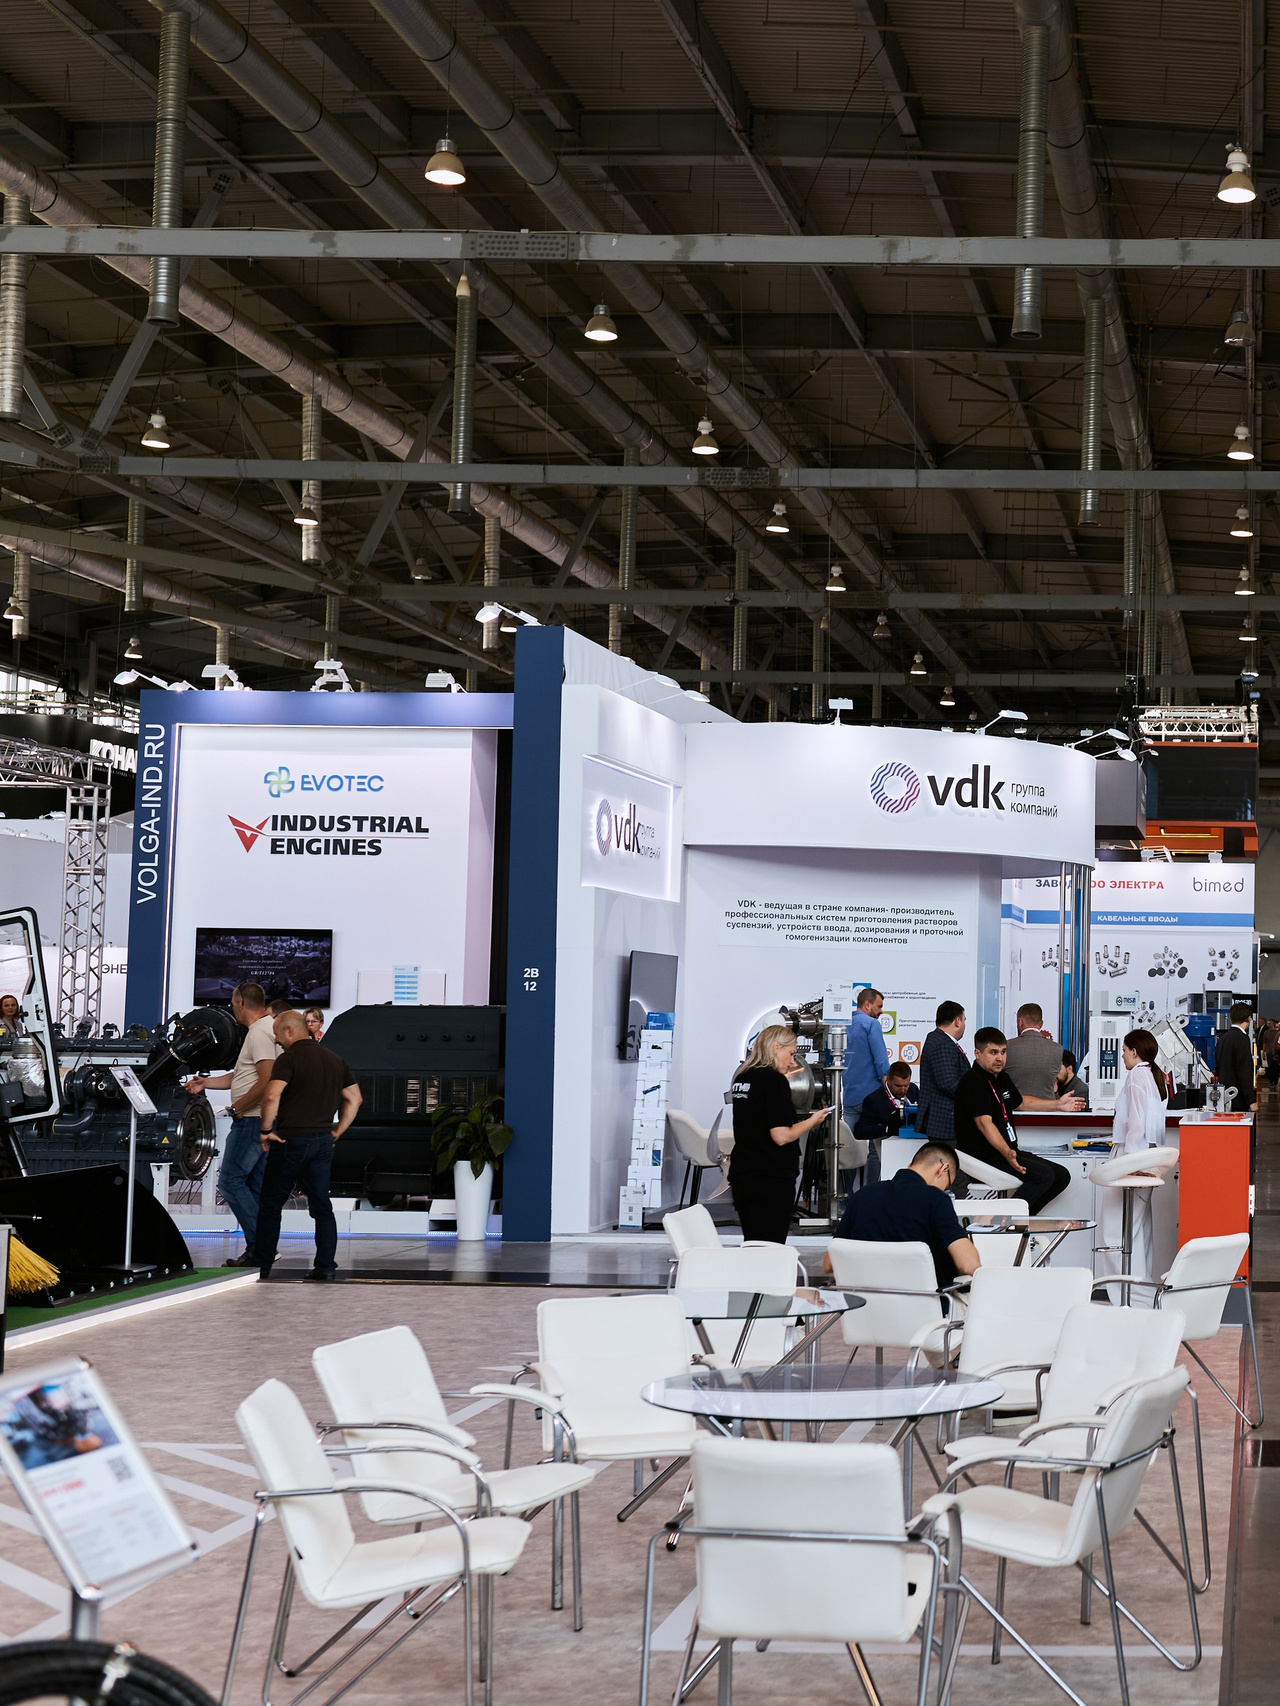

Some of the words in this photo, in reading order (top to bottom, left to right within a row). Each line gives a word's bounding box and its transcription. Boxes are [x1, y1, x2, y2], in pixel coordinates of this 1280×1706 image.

[90, 739, 138, 773] КОНА
[301, 775, 384, 792] EVOTEC
[927, 764, 1006, 810] vdk
[1011, 782, 1045, 797] группа
[137, 724, 165, 904] VOLGA-IND.RU
[1010, 802, 1058, 818] компаний
[271, 814, 430, 833] INDUSTRIAL
[614, 803, 640, 854] vdk
[270, 838, 382, 856] ENGINES
[1110, 880, 1165, 890] ЭЛЕКТРА
[1193, 877, 1244, 893] bimed
[737, 899, 756, 908] VDK
[764, 902, 803, 911] ведущая
[812, 904, 842, 912] стране
[890, 907, 955, 916] производитель
[724, 910, 814, 921] профессиональных
[815, 914, 846, 922] систем
[848, 915, 912, 924] приготовления
[914, 919, 958, 927] растворов
[726, 921, 775, 930] суспензий,
[776, 922, 822, 932] устройств
[824, 926, 852, 934] ввода,
[854, 925, 910, 935] дозирования
[919, 928, 964, 937] проточной
[785, 933, 850, 943] гомогенизации
[852, 936, 908, 945] компонентов
[523, 967, 540, 978] 2B
[523, 981, 537, 991] 12
